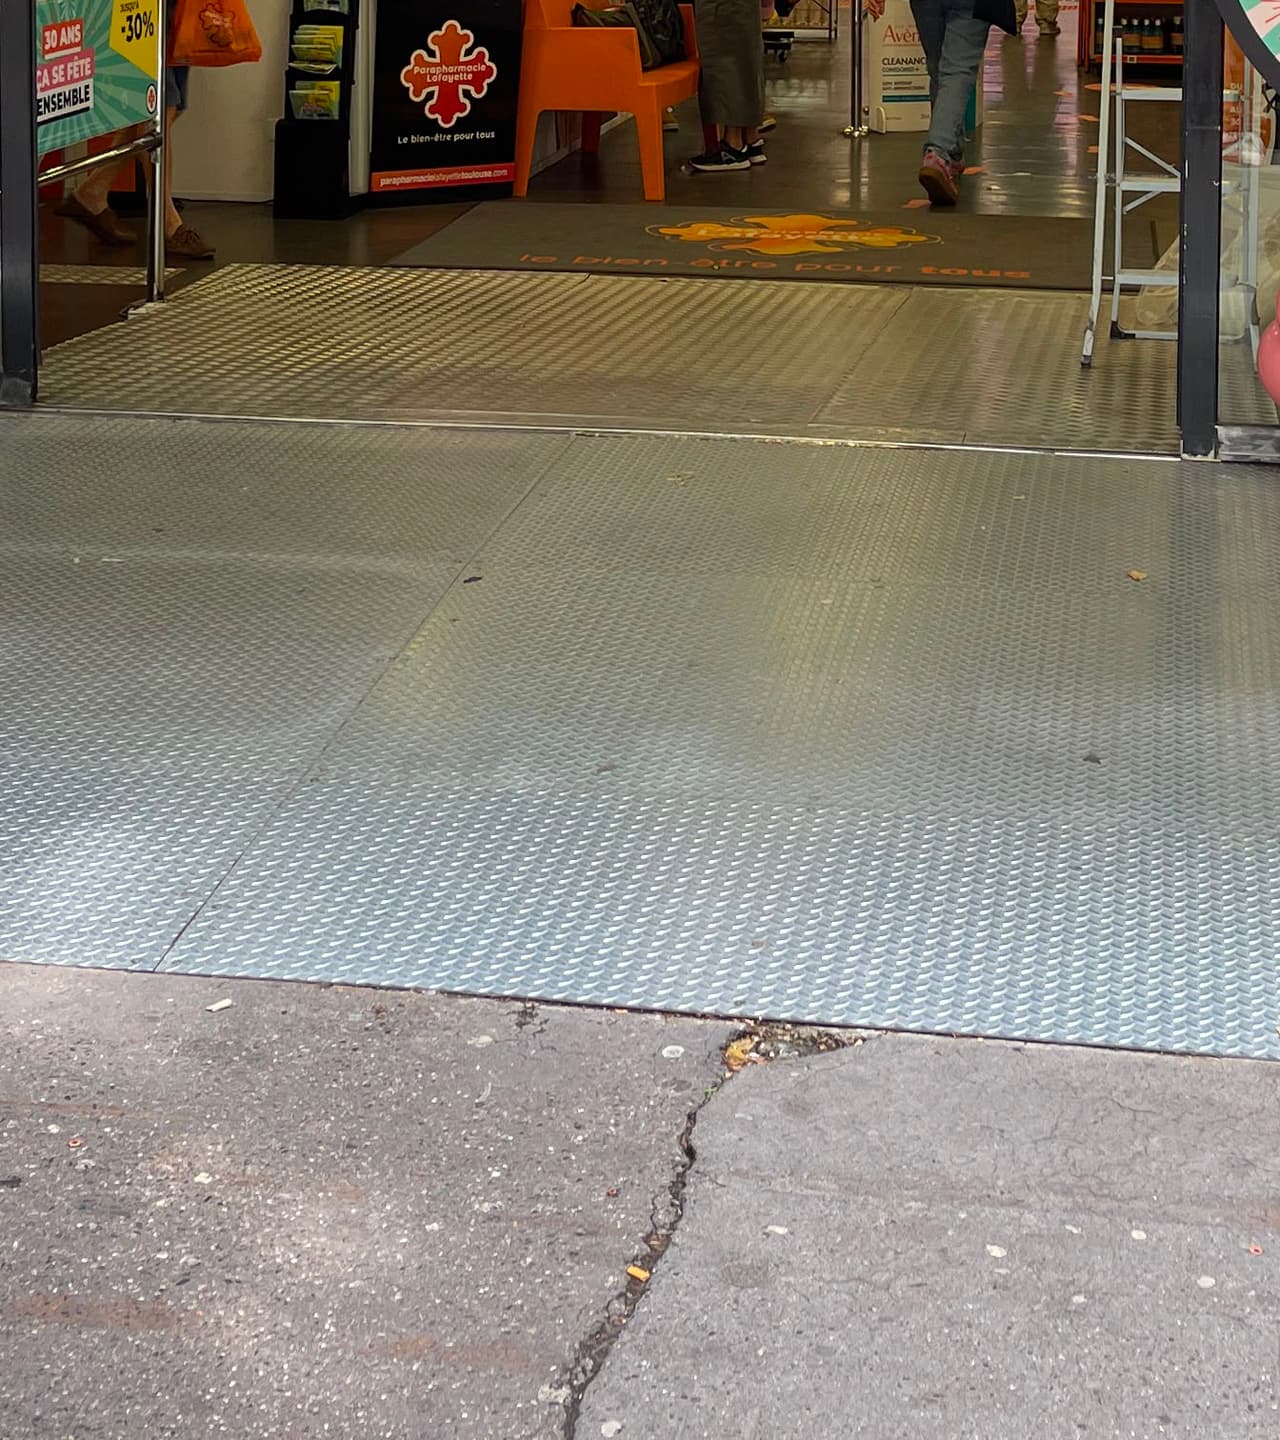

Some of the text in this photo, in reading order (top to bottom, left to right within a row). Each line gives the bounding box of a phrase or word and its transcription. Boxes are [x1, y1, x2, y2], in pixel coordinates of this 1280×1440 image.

[121, 11, 154, 42] -30%
[882, 23, 920, 43] Avèn
[44, 24, 81, 50] 30 ANS
[52, 64, 65, 83] SE
[67, 56, 92, 80] FÊTE
[413, 63, 487, 75] Parapharmacie
[882, 57, 926, 66] CLEANANC
[426, 72, 473, 83] Lafayette
[37, 84, 90, 115] ENSEMBLE
[398, 131, 495, 144] Le bien-être pour tous
[795, 263, 902, 274] pour
[919, 265, 1034, 279] tous
